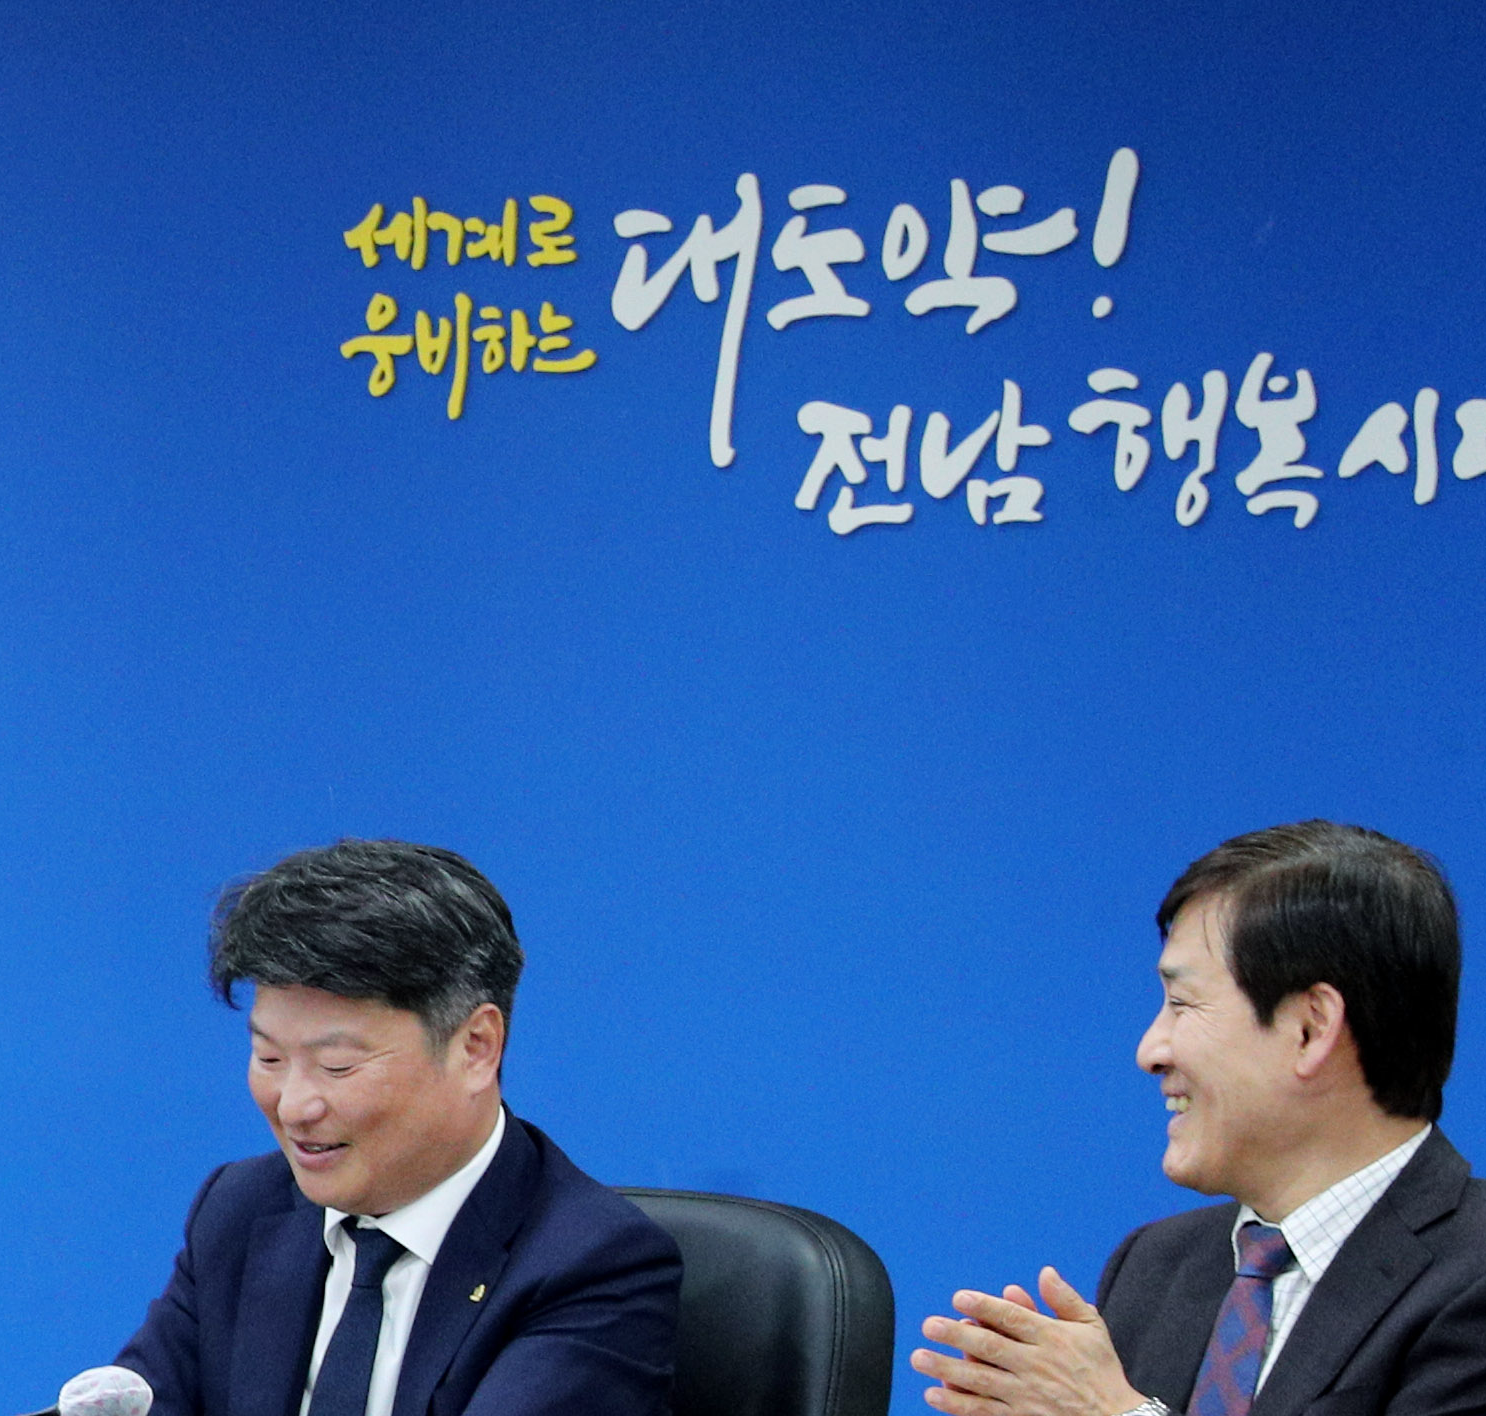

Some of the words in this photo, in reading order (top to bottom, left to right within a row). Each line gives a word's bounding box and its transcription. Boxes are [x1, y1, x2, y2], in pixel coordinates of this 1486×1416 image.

[343, 196, 577, 270] 세계로
[612, 148, 1138, 467] 대도약!
[340, 293, 596, 421] 웅비하는
[795, 380, 1051, 535] 전남
[1068, 353, 1325, 528] 행복
